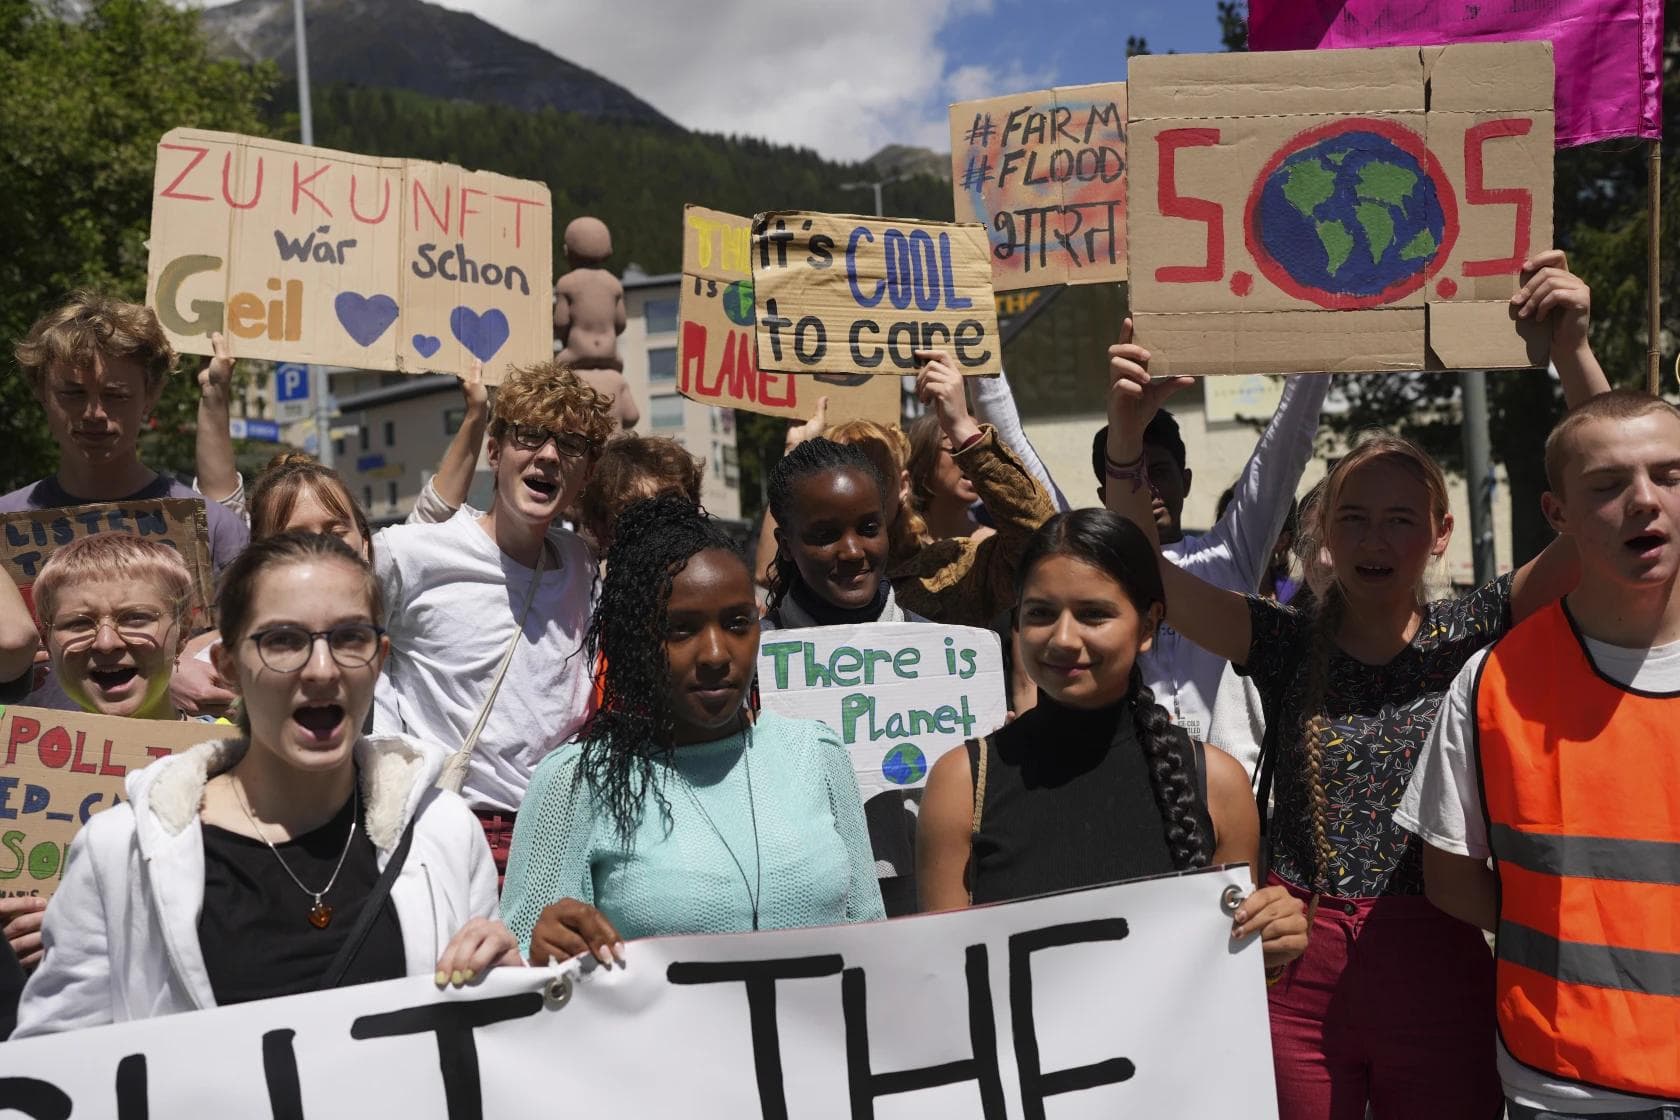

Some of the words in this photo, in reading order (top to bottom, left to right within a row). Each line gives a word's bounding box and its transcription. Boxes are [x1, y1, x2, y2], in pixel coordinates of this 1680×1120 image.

[159, 143, 545, 248] ZUKUNFT
[959, 145, 1125, 193] #FLOOD
[845, 225, 973, 312] COOL
[993, 199, 1122, 273] भारत
[154, 254, 304, 339] Geil
[761, 297, 828, 366] to
[848, 318, 992, 368] care
[285, 371, 300, 398] P
[6, 509, 168, 547] LISTEN
[13, 551, 52, 576] T
[762, 640, 921, 690] There
[944, 637, 977, 680] is
[6, 715, 127, 777] POLL
[666, 917, 1136, 1120] THE
